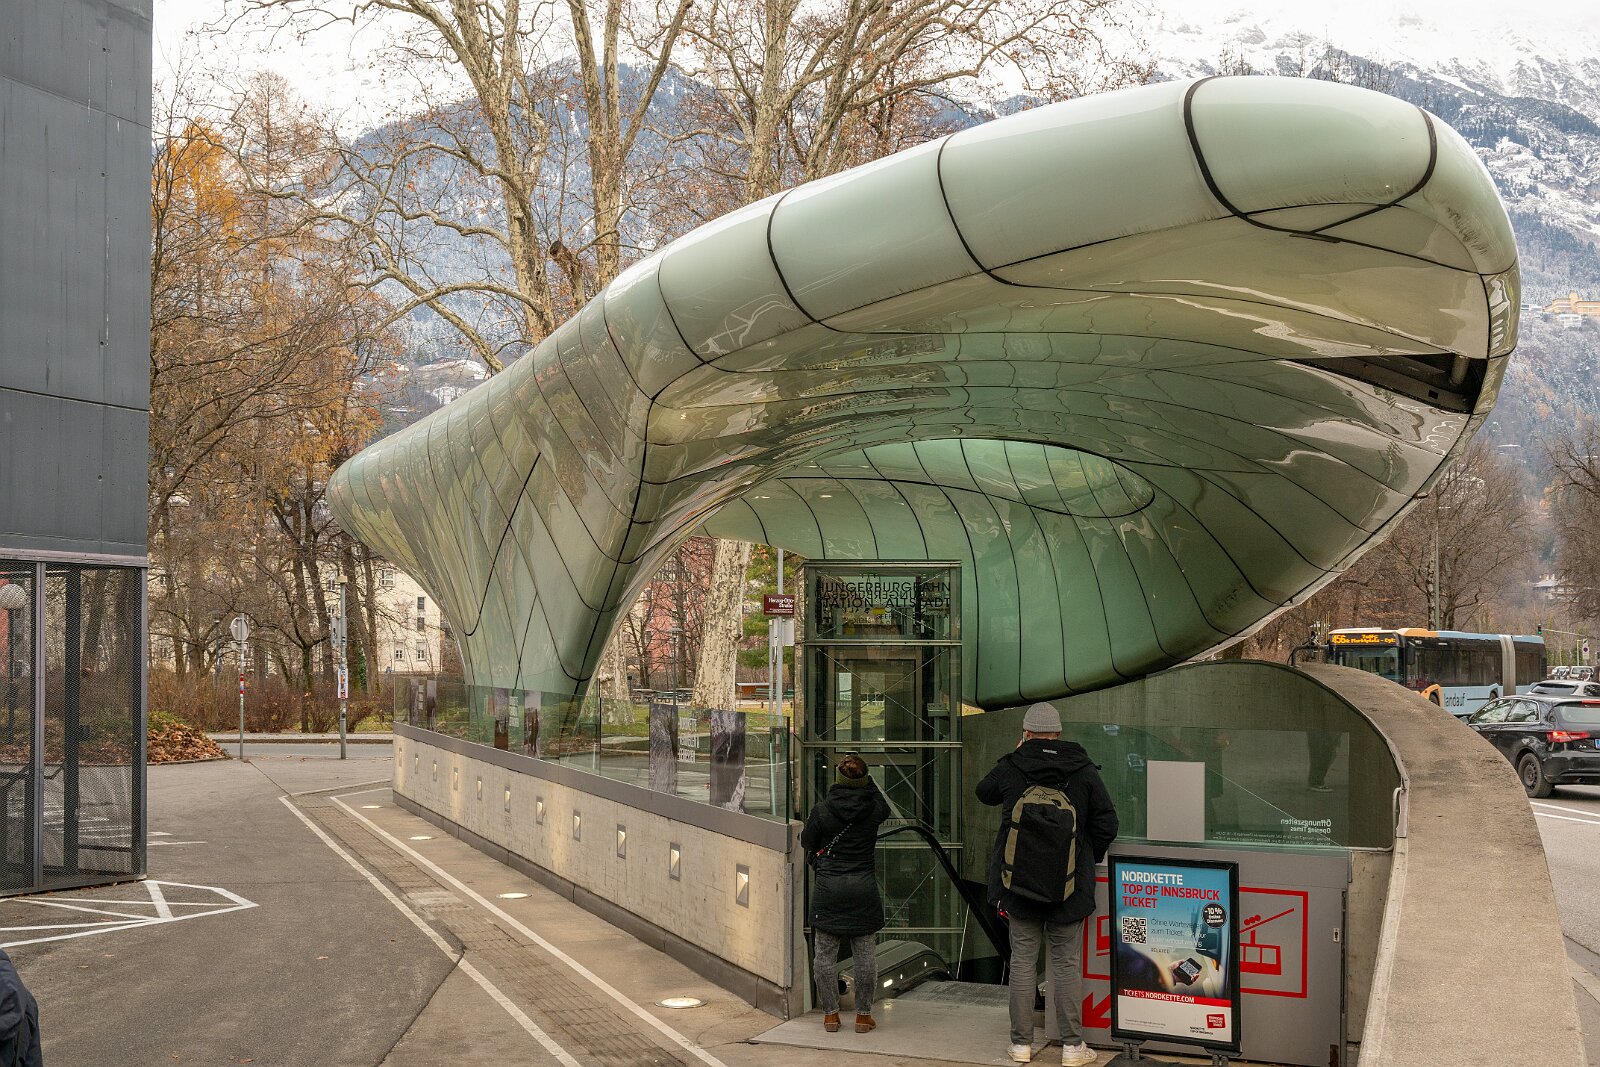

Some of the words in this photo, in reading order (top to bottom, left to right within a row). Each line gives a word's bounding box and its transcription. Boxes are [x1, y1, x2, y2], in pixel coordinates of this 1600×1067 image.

[817, 582, 950, 592] HUNGERBURGBAHN
[817, 598, 873, 607] TATION
[1444, 692, 1466, 707] landauf
[1121, 870, 1183, 886] NORDKETTE
[1122, 883, 1143, 895] TOP
[1145, 885, 1159, 896] OF
[1161, 886, 1220, 901] INNSBRUCK
[1122, 896, 1158, 908] TICKET
[1151, 918, 1168, 927] Ohne
[1168, 920, 1204, 929] Wartezeen
